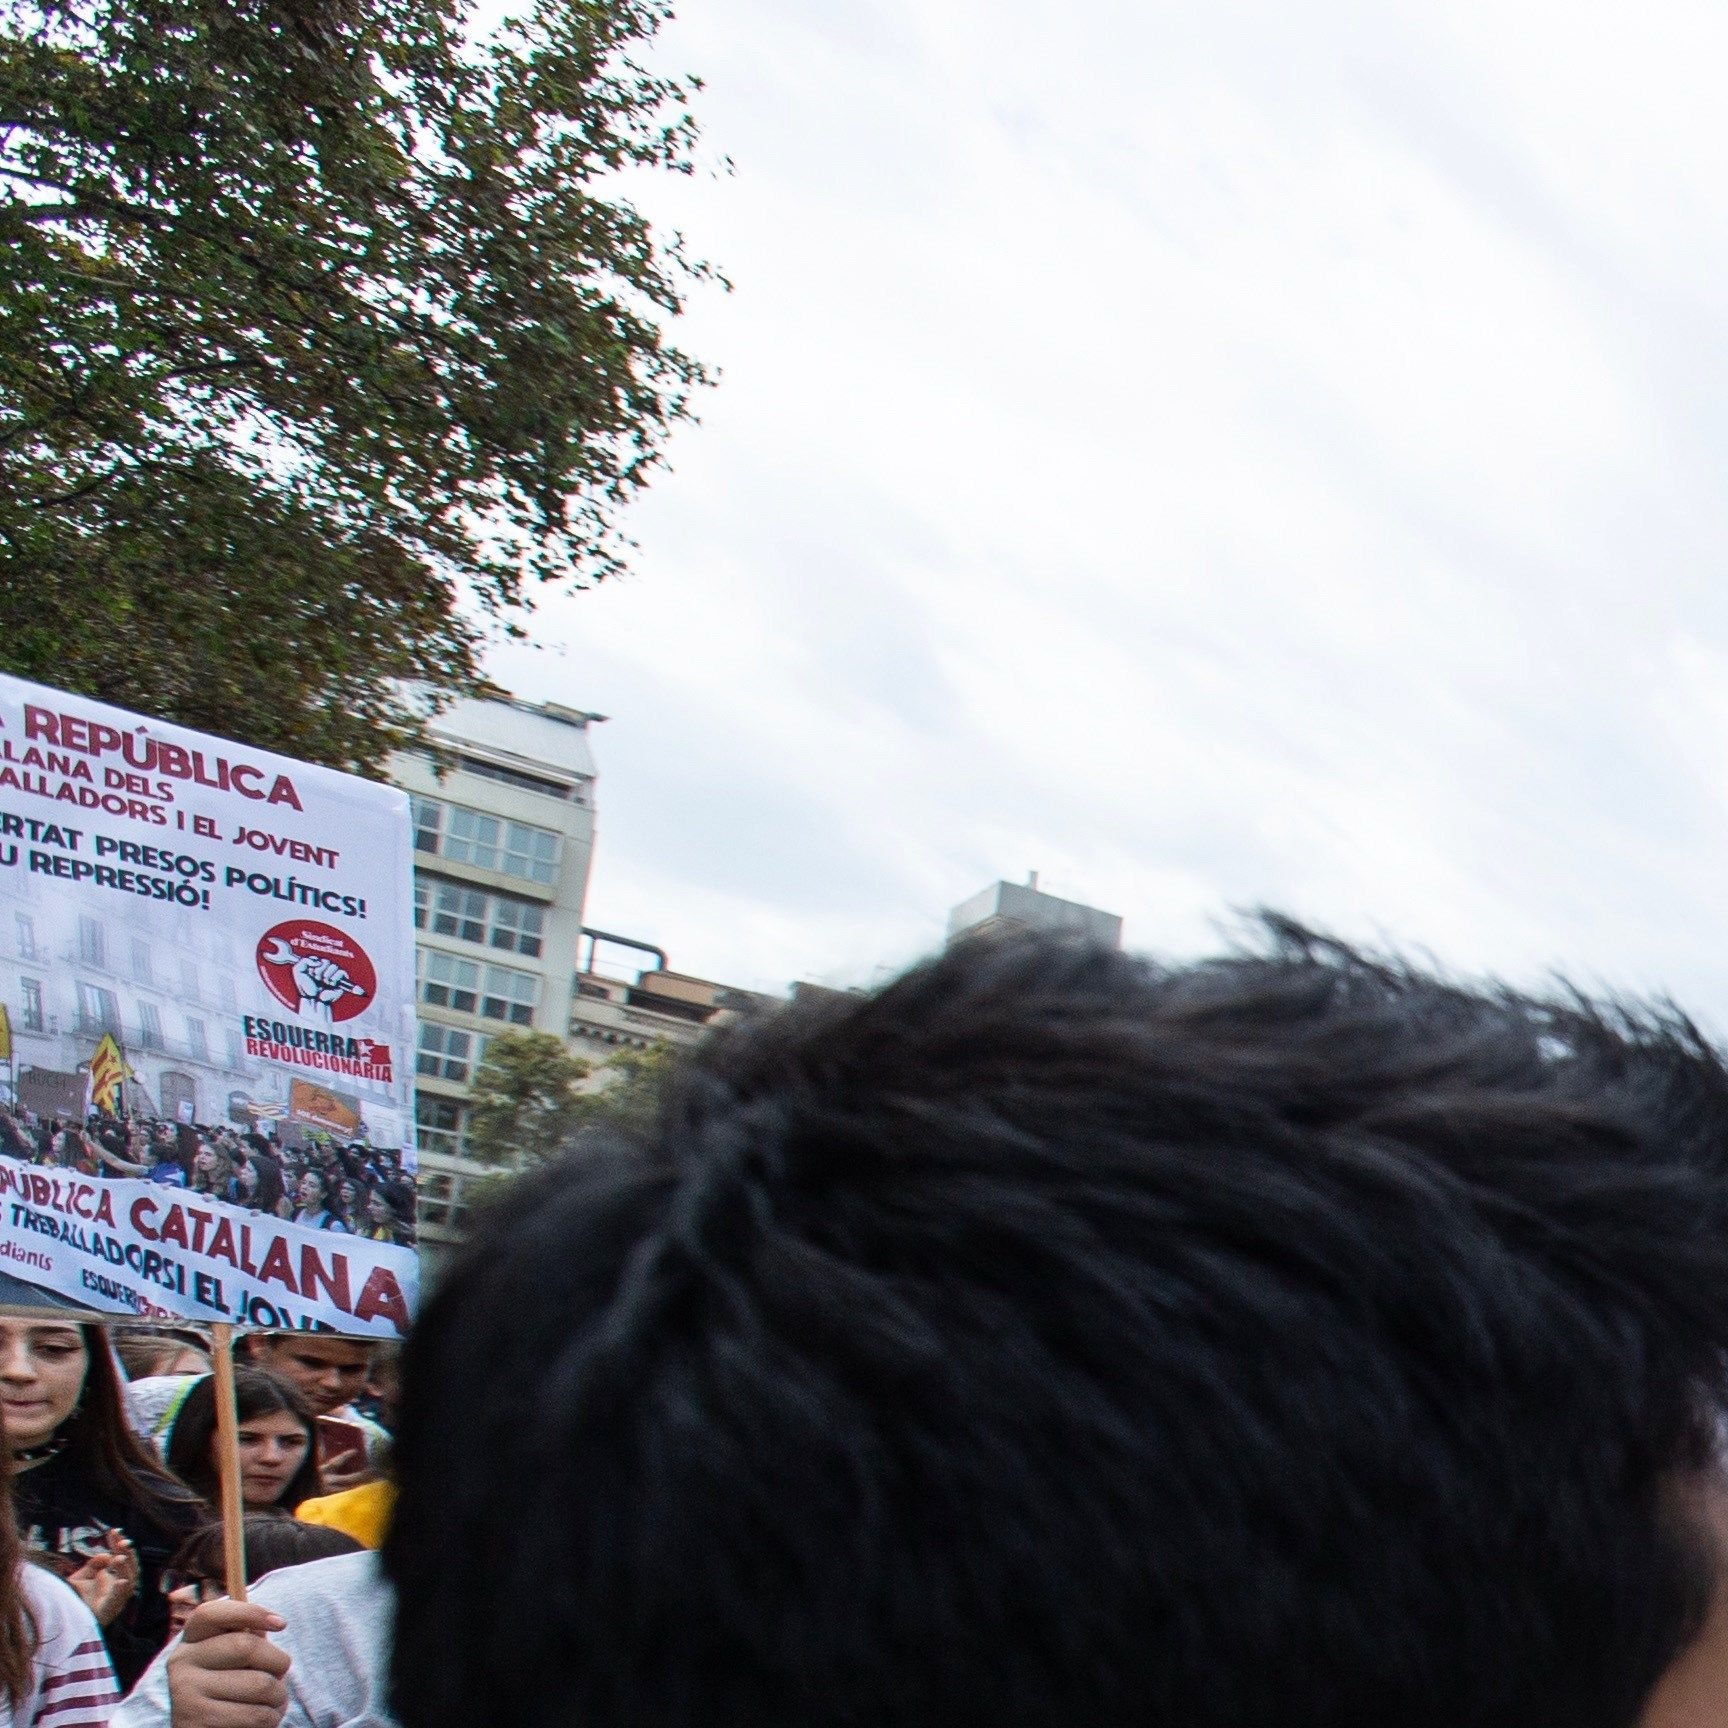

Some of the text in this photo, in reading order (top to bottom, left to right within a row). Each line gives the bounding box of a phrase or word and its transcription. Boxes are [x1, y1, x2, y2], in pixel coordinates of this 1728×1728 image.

[0, 740, 174, 802] LANA DELS
[24, 703, 303, 812] REPÚBLICA
[0, 812, 367, 919] RTAT PRESOS POLÍTICS!
[177, 810, 185, 830] I
[194, 814, 222, 840] EL
[233, 827, 339, 869] JOVENT
[30, 850, 210, 910] REPRESSIÓ!
[244, 1015, 361, 1060] ESQUERRA
[246, 1038, 392, 1083] REVOLUCIONARIA
[130, 1197, 410, 1334] CATALANA
[194, 1271, 230, 1315] EL
